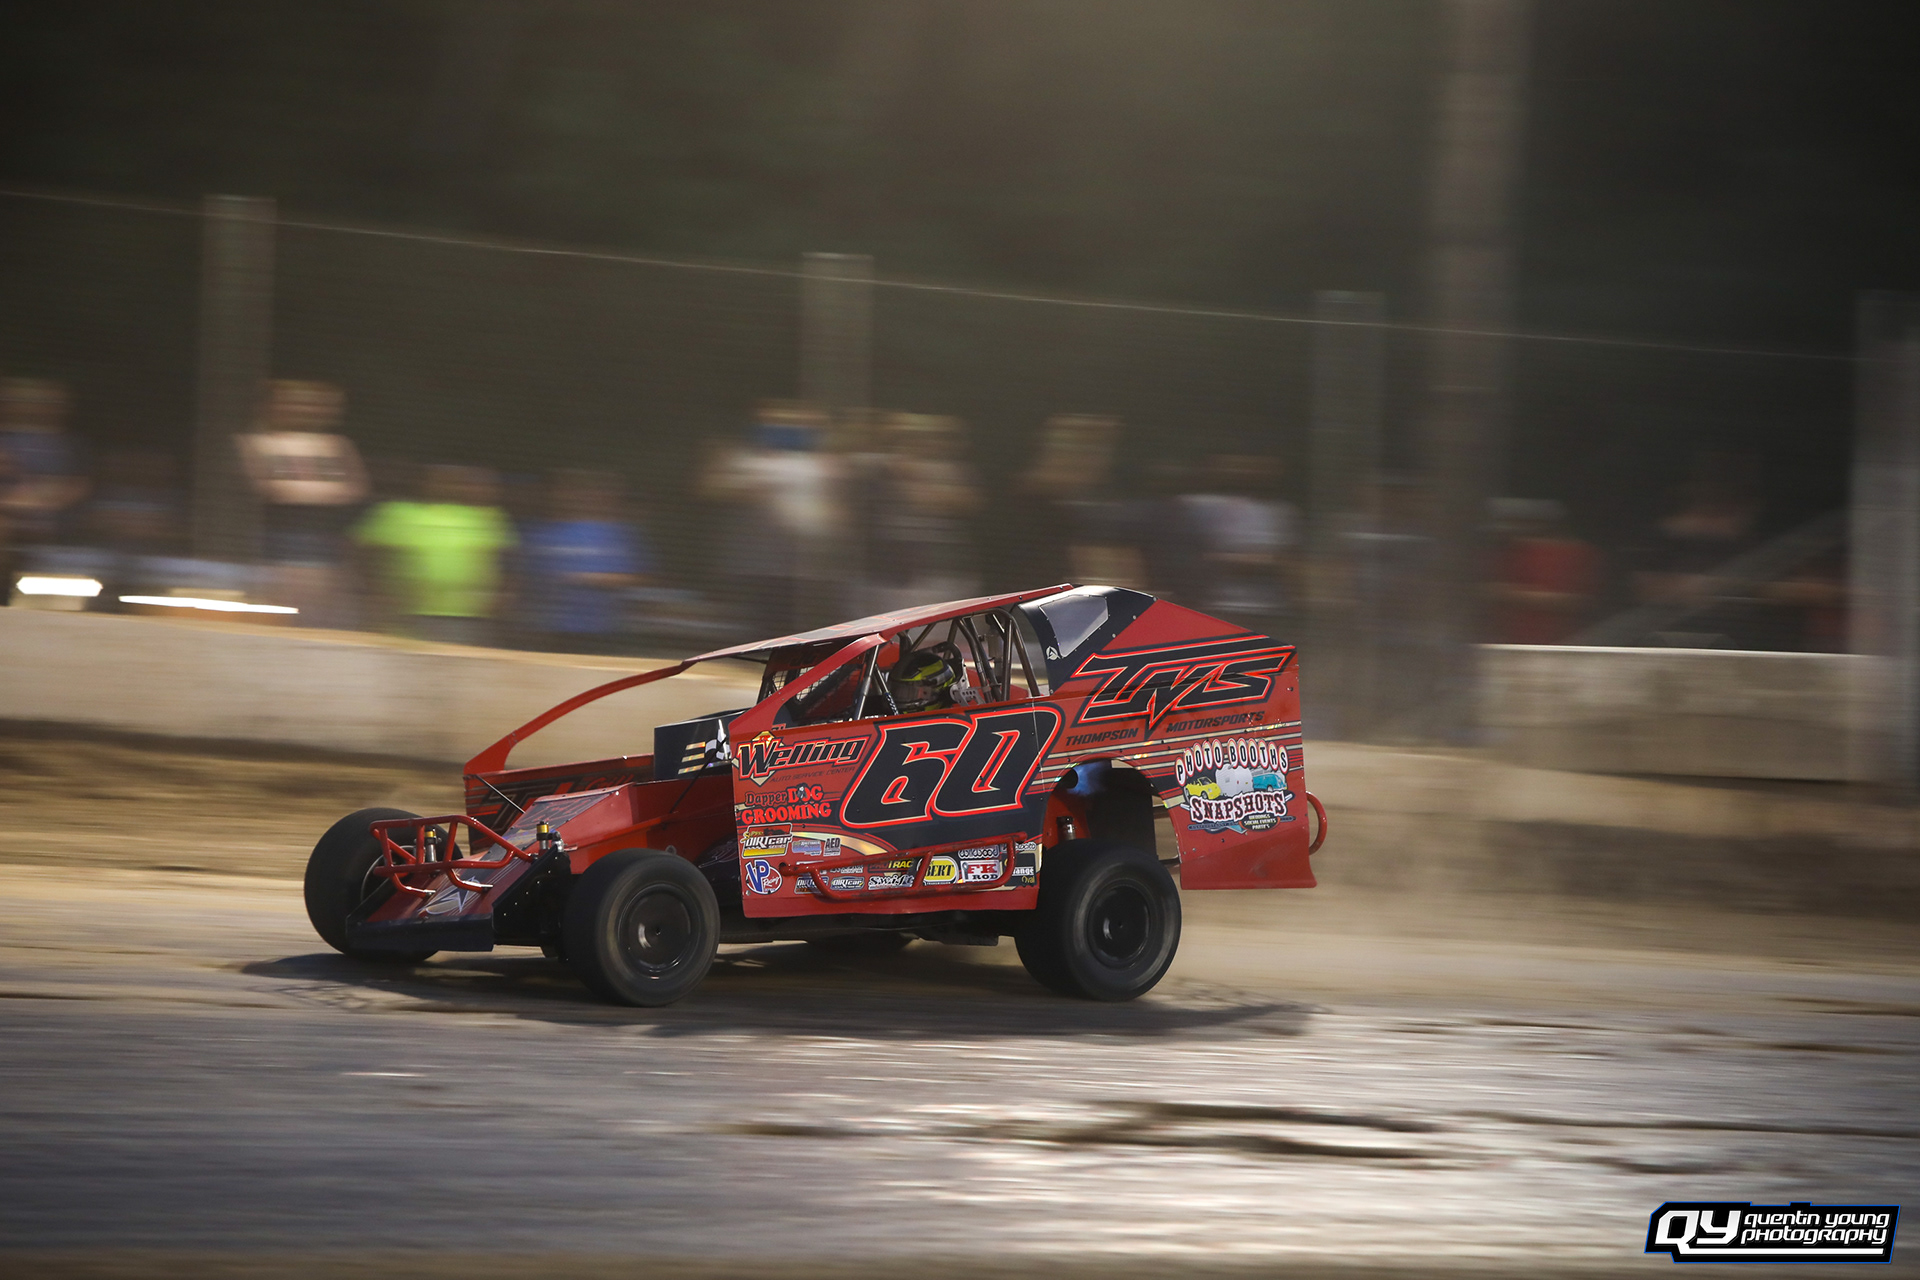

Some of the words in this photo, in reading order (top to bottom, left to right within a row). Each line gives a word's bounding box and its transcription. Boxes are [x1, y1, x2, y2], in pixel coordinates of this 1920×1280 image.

[1066, 728, 1138, 747] THOMPSON
[1166, 711, 1264, 732] MOTORSPORTS
[738, 739, 869, 778] Welling
[841, 708, 1059, 827] 60
[1177, 747, 1221, 781] PHOTO
[1230, 746, 1286, 769] BOOTHS
[771, 774, 791, 783] AUTO
[793, 771, 823, 780] SERVICE
[741, 803, 832, 824] GROOMING
[746, 791, 787, 806] Dapper
[1190, 793, 1285, 821] SNAPSHOTS
[745, 860, 771, 893] VP
[967, 863, 997, 874] FK
